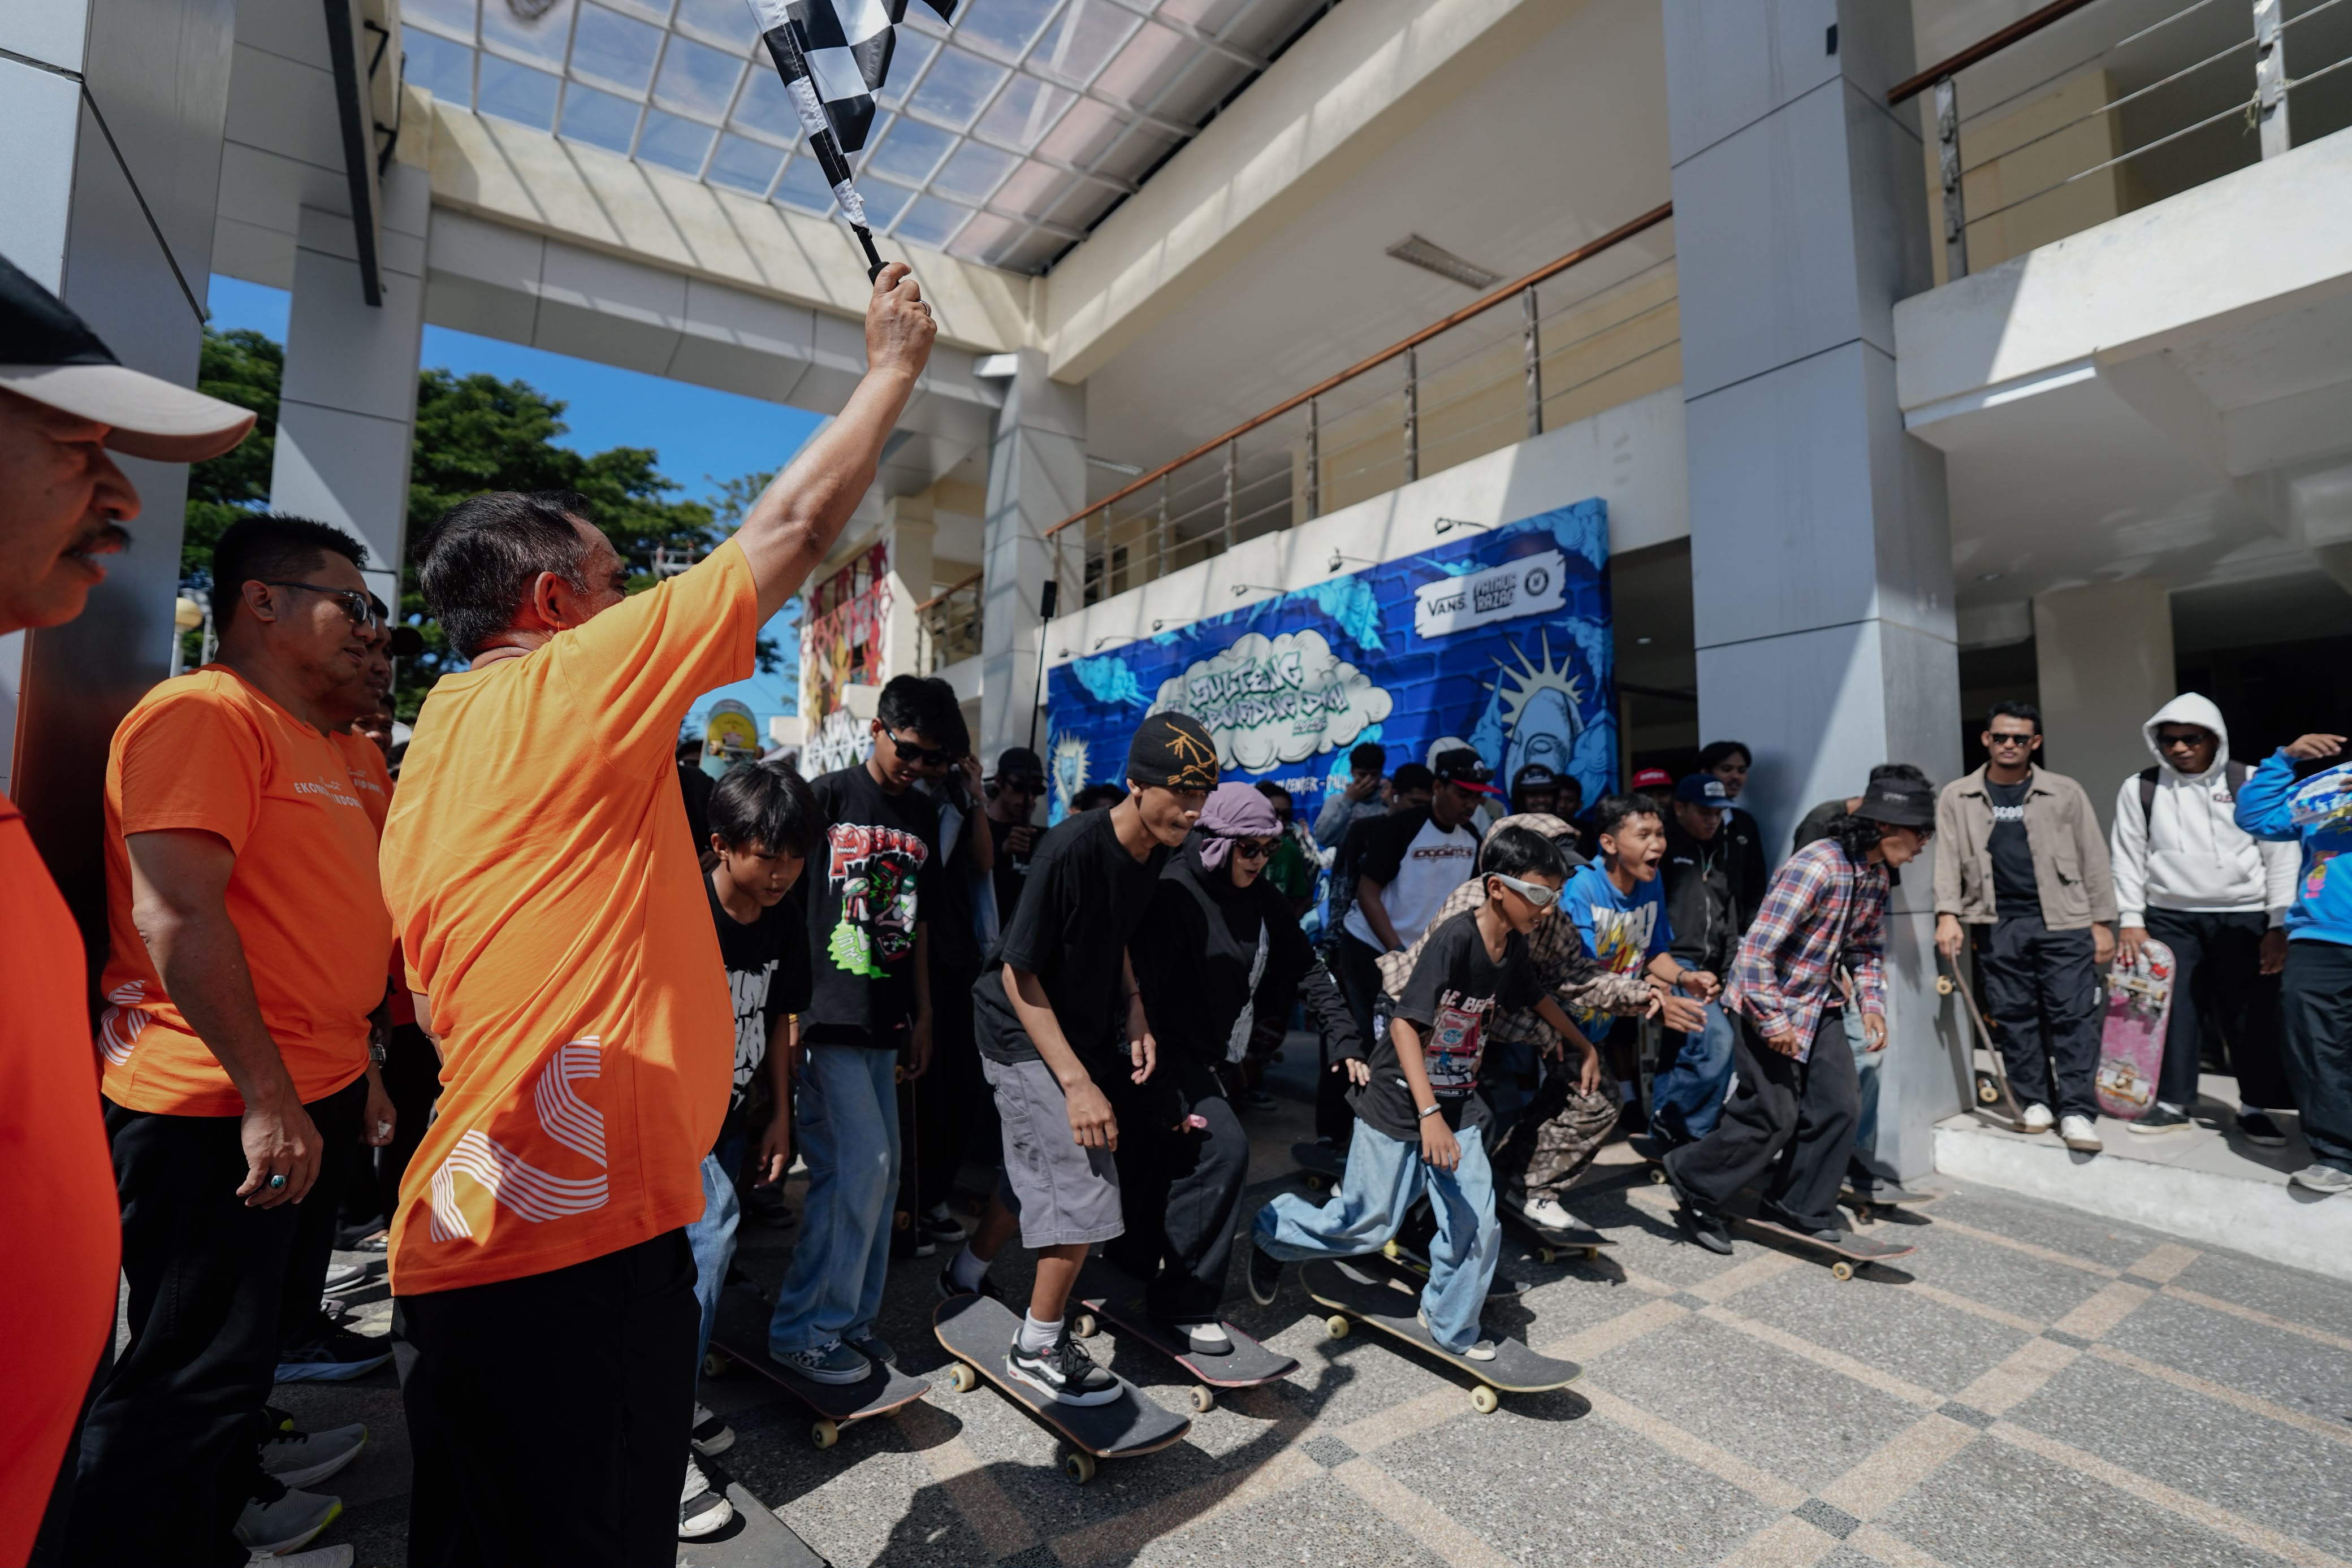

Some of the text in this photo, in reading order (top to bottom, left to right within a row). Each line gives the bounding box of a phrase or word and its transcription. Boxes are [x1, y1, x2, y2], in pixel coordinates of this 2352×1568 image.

[1428, 592, 1465, 616] VANS
[1190, 651, 1303, 708] SULTENG
[1302, 681, 1350, 716] DAY
[1285, 776, 1318, 796] CENTER
